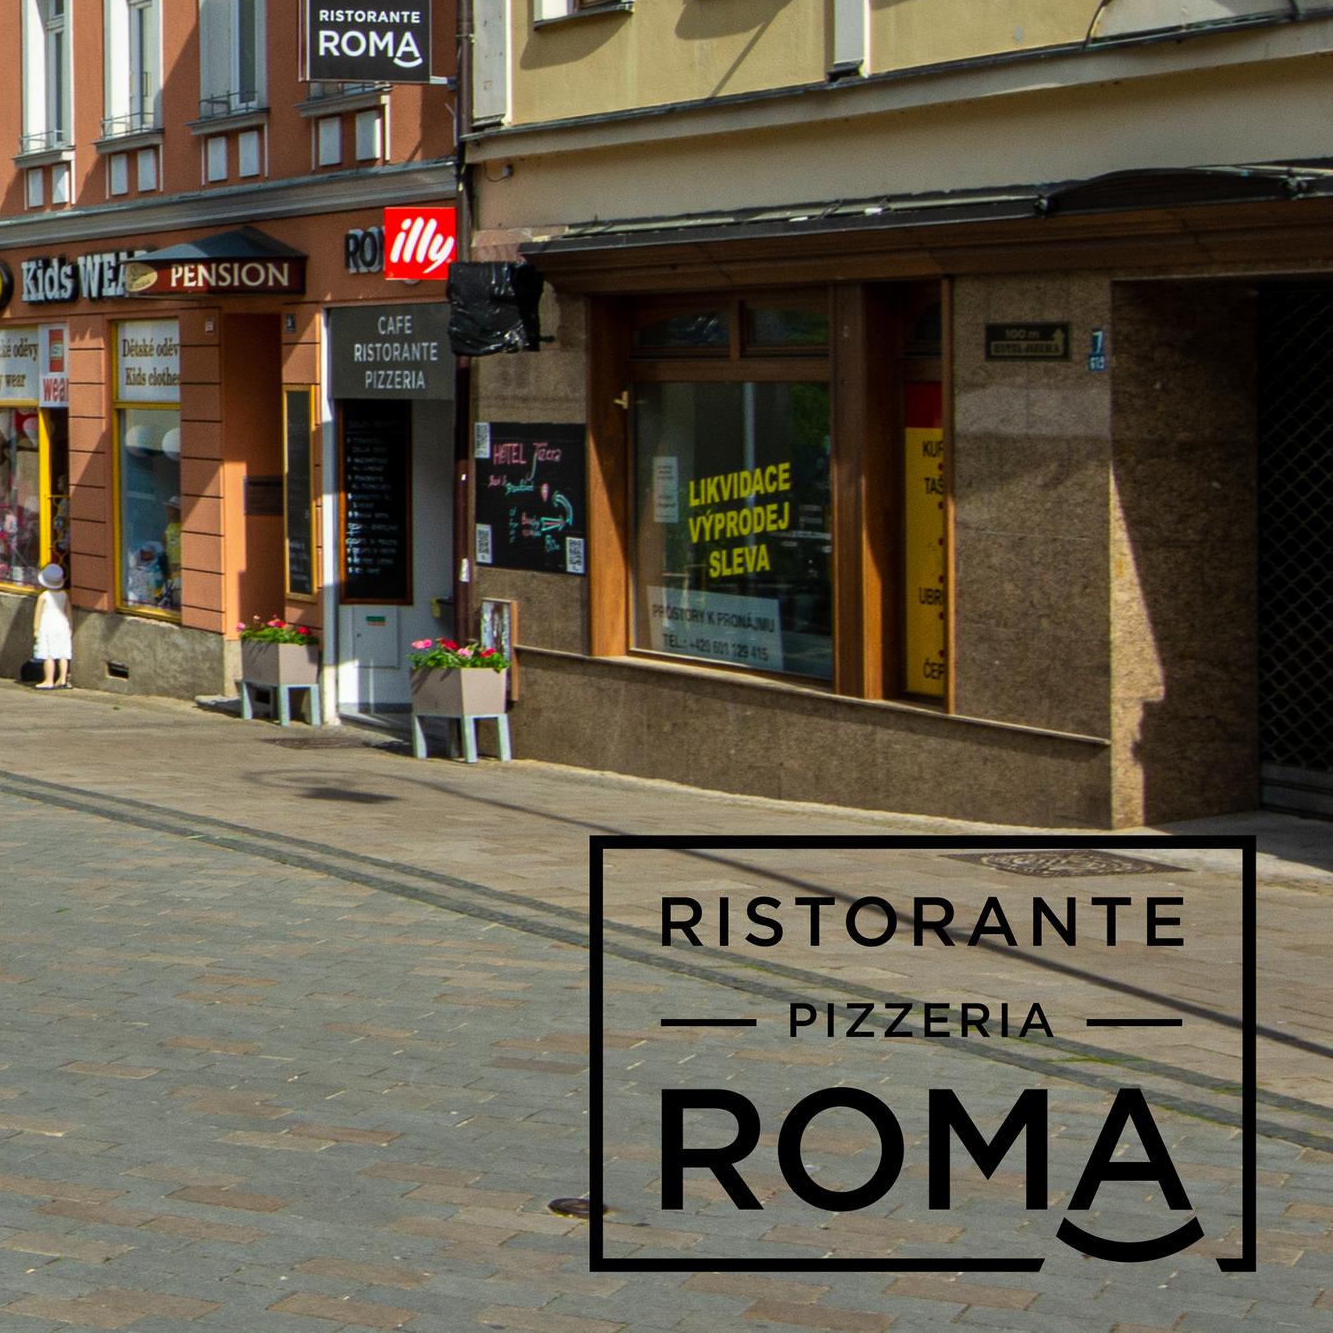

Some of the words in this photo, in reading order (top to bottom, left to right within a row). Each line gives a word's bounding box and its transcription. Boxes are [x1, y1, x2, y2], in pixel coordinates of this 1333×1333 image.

[319, 9, 421, 24] RISTORANTE
[318, 30, 422, 59] ROMA
[345, 227, 385, 274] RO
[389, 216, 455, 274] illy
[21, 258, 74, 303] Kids
[77, 250, 147, 299] WEA
[170, 262, 289, 287] PENSION
[377, 315, 413, 335] CAFE
[354, 342, 439, 362] RISTORANTE
[125, 368, 146, 386] Kids
[364, 369, 427, 389] PIZZERIA
[689, 462, 791, 507] LIKVIDACE
[689, 501, 790, 544] VÝPRODEJ
[709, 544, 771, 578] SLEVA
[652, 604, 704, 624] PROSTORY
[706, 611, 716, 624] K
